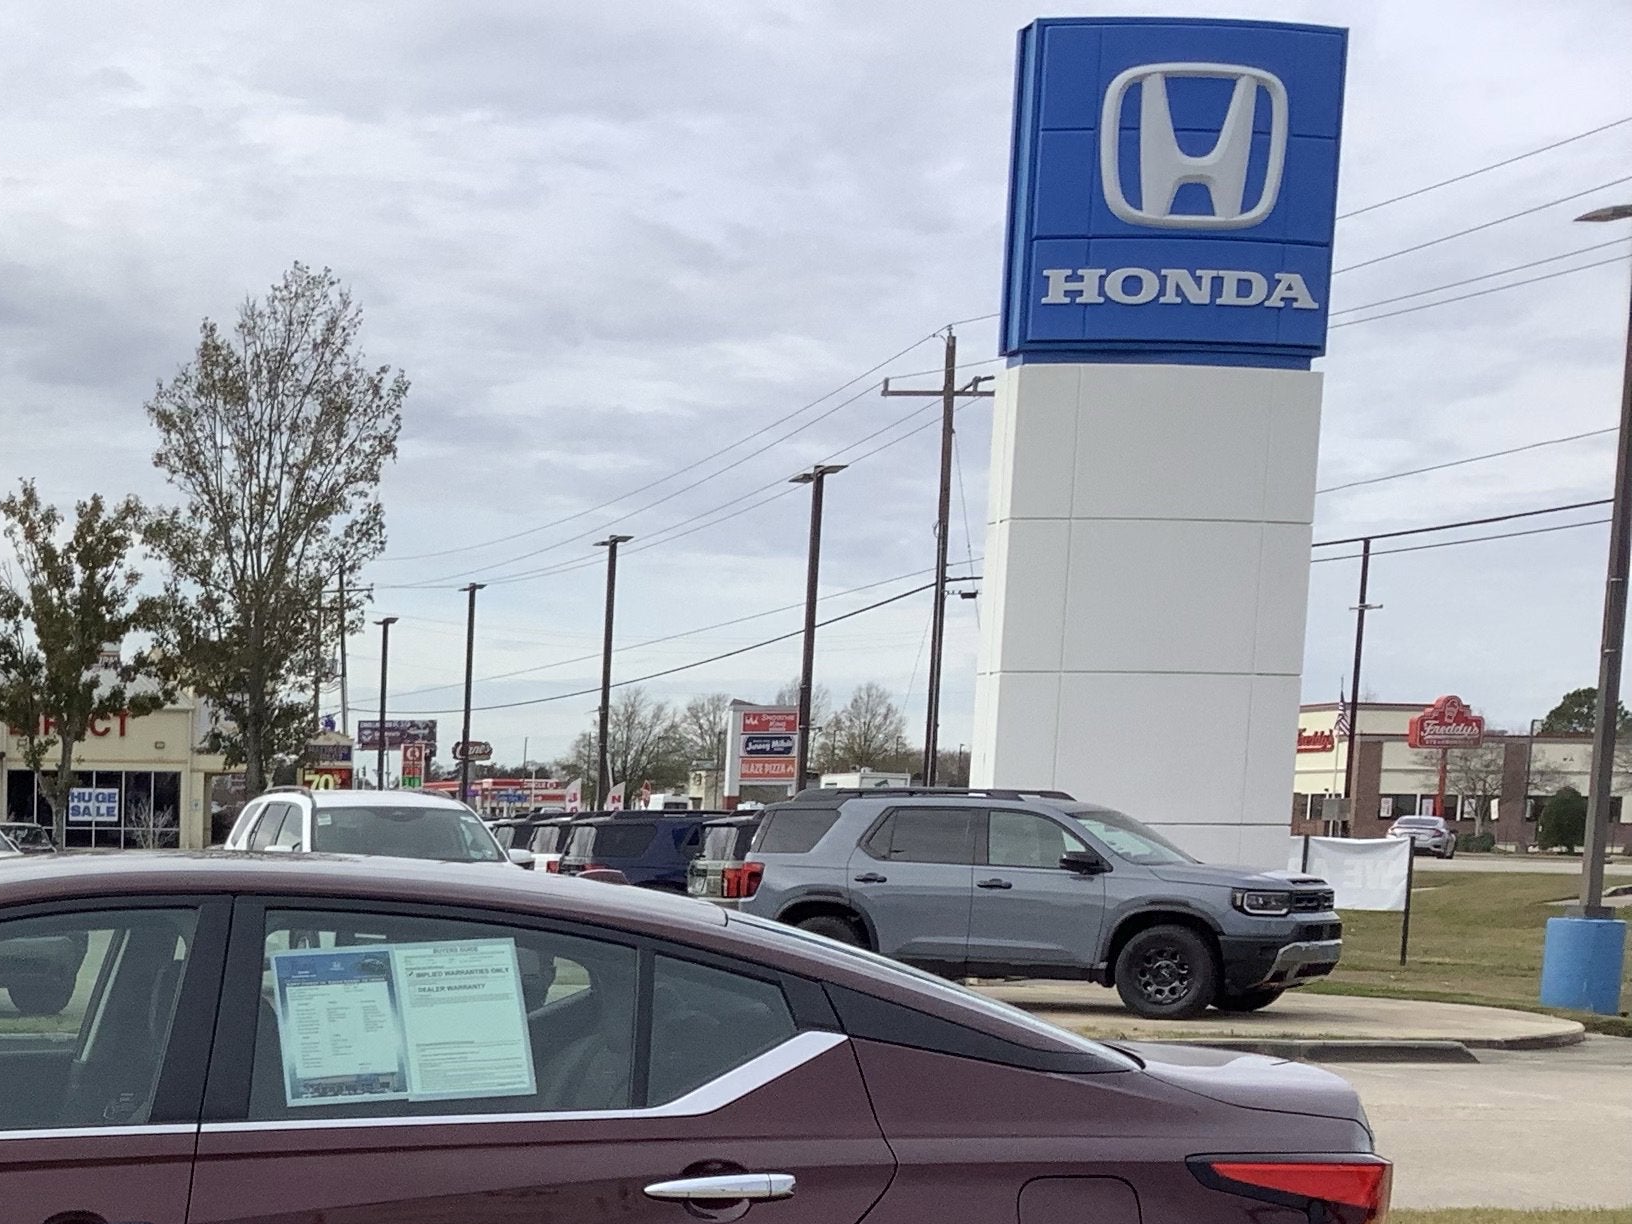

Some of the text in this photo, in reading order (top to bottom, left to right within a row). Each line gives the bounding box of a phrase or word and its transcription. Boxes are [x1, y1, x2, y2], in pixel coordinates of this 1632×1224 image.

[1041, 267, 1319, 310] HONDA
[1421, 719, 1479, 738] Freddy's
[764, 763, 786, 774] PIZZA
[69, 791, 117, 804] HUGE
[69, 805, 117, 817] SALE
[415, 970, 444, 979] IMPLIED
[444, 967, 490, 977] WARRANTIES
[447, 983, 487, 991] WARRANTY
